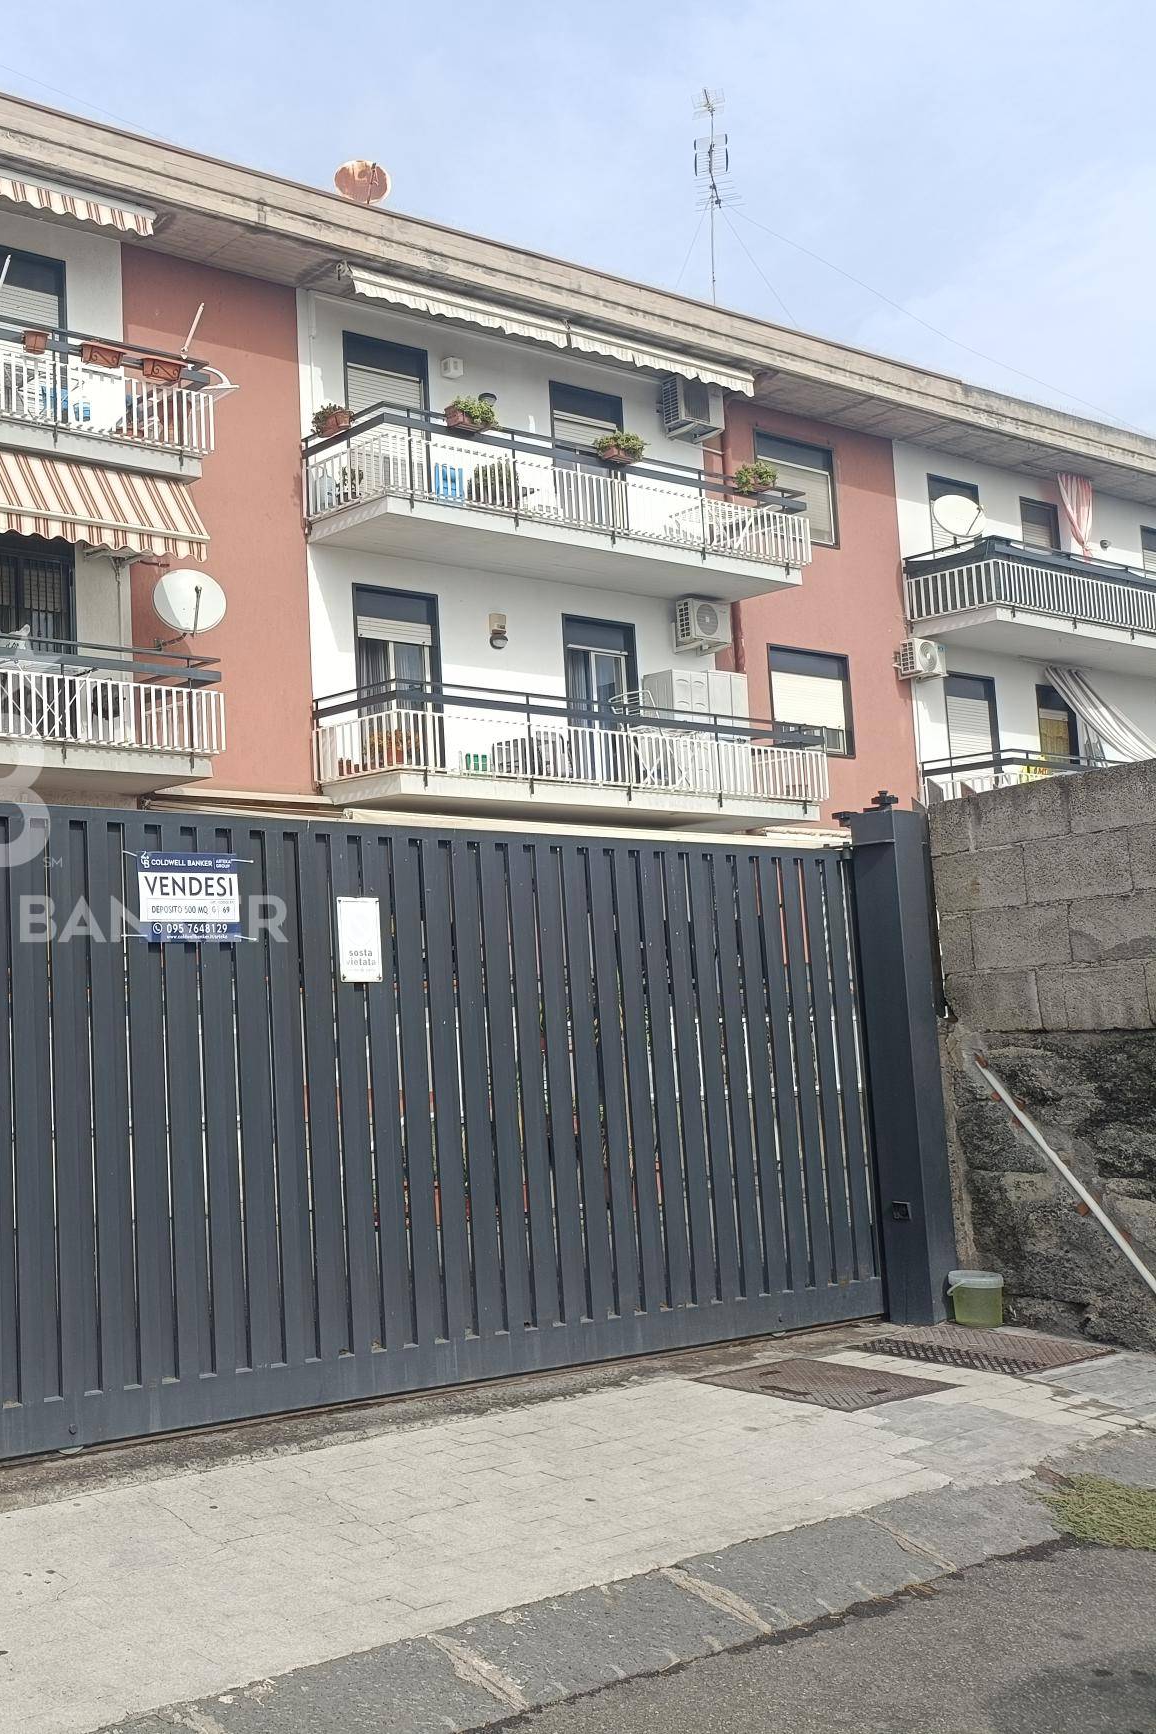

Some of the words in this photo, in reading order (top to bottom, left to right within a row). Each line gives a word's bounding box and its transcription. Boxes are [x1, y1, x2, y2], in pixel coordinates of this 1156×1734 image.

[151, 859, 186, 867] COLDWELL
[144, 876, 233, 896] VENDESI
[151, 905, 183, 914] DEPOSITO
[184, 906, 197, 914] 500
[197, 906, 209, 915] MQ
[166, 923, 184, 934] 095
[188, 923, 228, 934] 7648129
[346, 957, 376, 965] vietata
